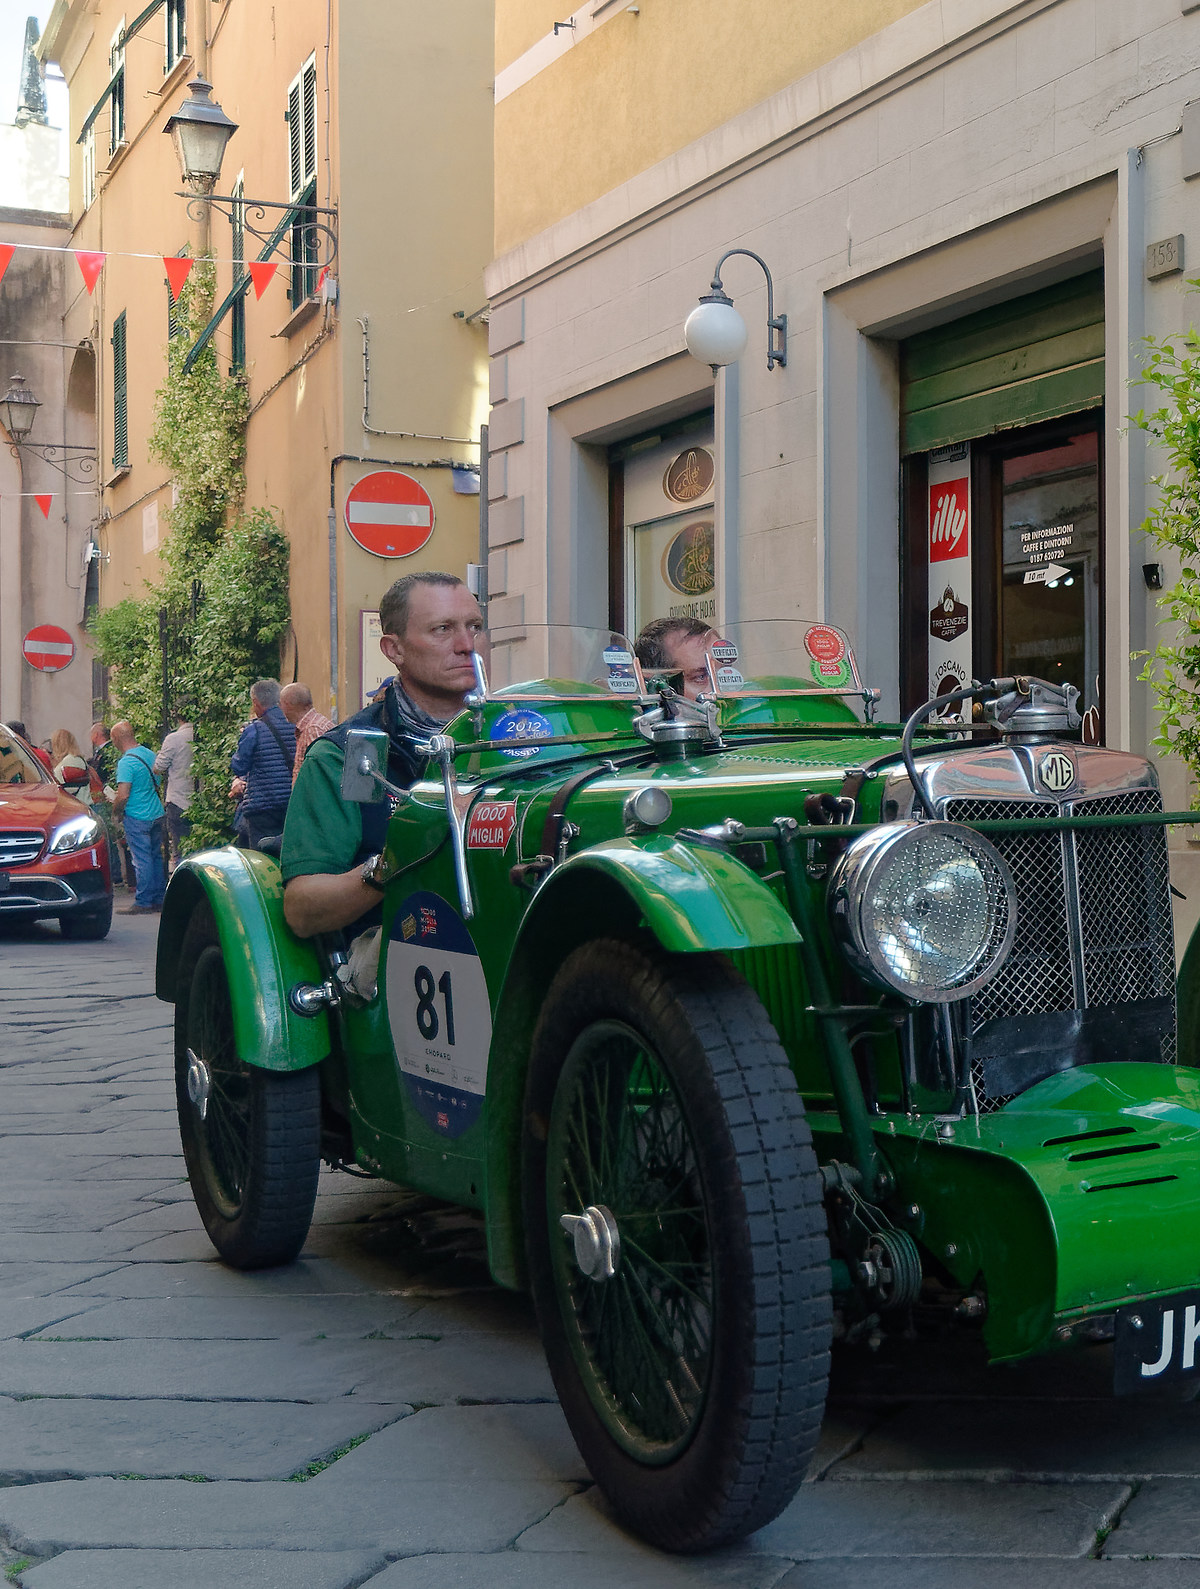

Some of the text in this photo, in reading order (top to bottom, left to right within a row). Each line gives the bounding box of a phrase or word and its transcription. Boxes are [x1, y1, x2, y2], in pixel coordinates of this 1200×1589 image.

[931, 493, 967, 552] illy
[1021, 523, 1074, 542] PER INFORMAZIONI
[1022, 536, 1072, 553] CAFFE E DINTORNI
[1029, 549, 1065, 564] 0187 620720
[932, 615, 967, 628] TREVENEZIE
[712, 648, 738, 657] VERIFICATO
[935, 659, 966, 681] TOSCANO
[718, 675, 742, 684] VERIFICATO
[506, 721, 542, 732] 2012
[1046, 757, 1072, 787] MG
[476, 806, 507, 821] 1000
[470, 827, 504, 844] MIGLIA
[414, 965, 455, 1046] 81
[425, 1048, 452, 1061] CHOPARD
